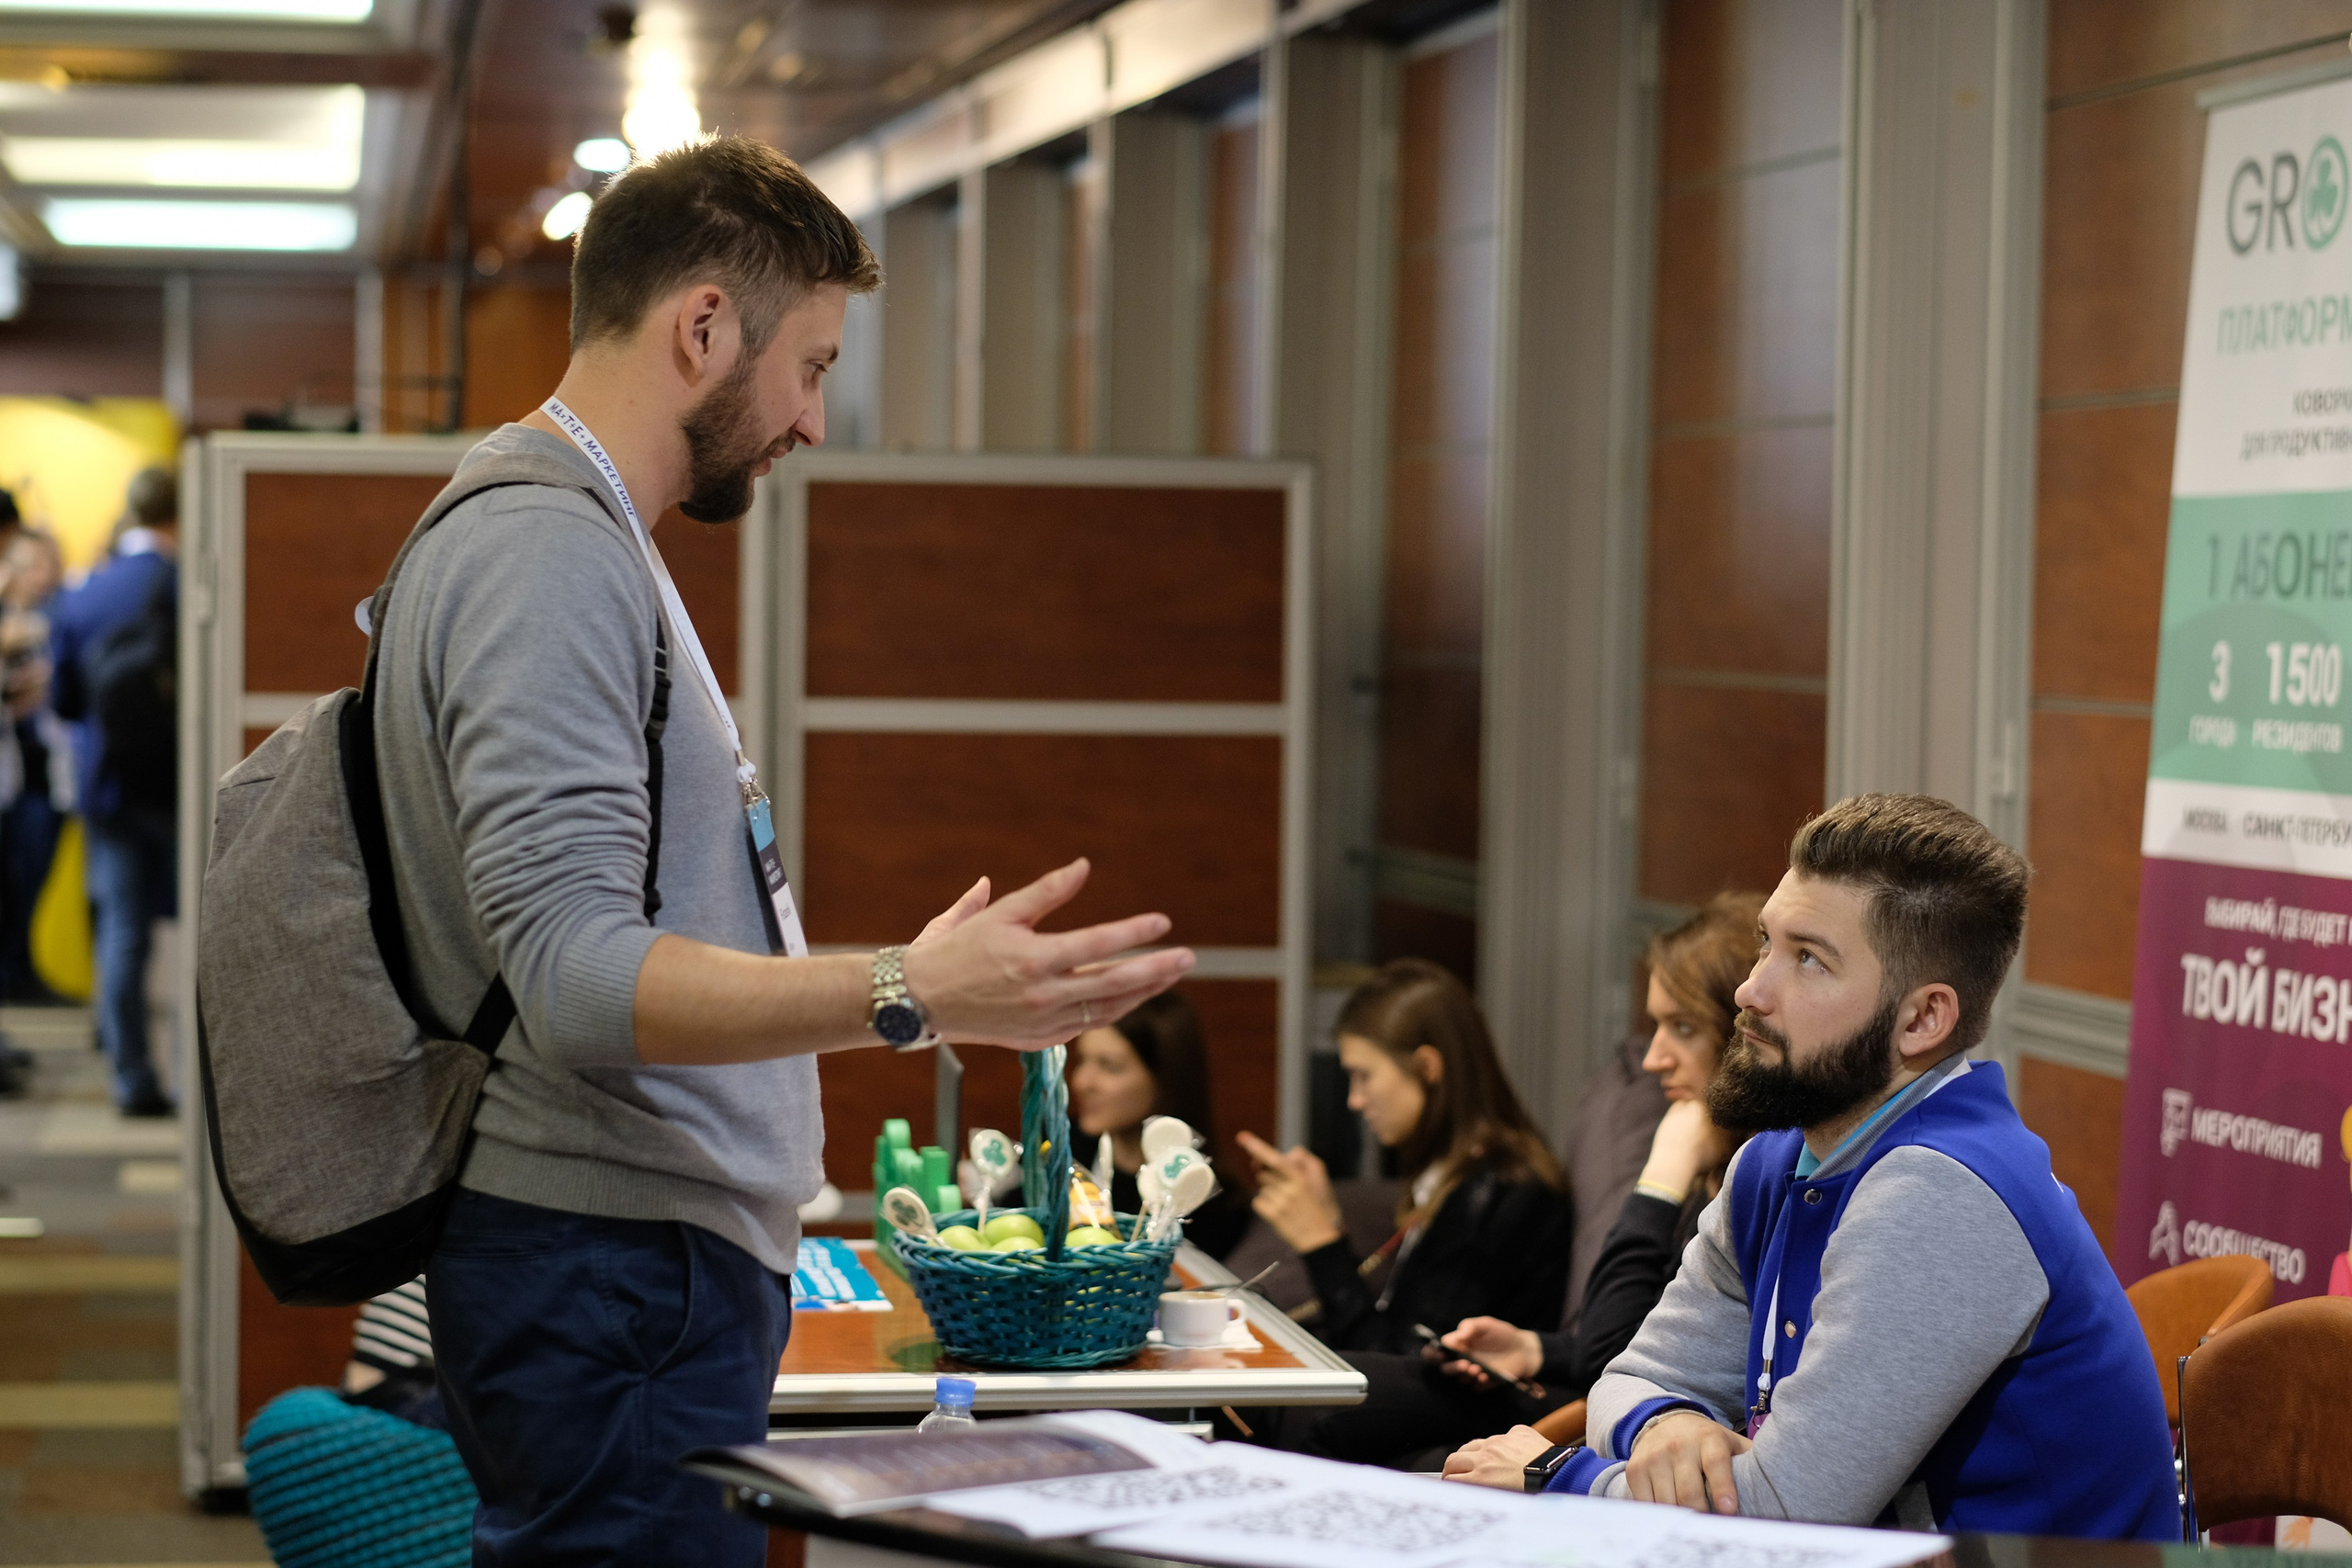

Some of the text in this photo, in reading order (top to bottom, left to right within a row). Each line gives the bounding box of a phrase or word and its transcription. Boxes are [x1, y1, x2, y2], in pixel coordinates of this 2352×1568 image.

[2207, 529, 2352, 601] 1 АБОНЕ
[2209, 639, 2232, 704] 3
[2180, 946, 2269, 1030] ТВОЙ
[2191, 1106, 2323, 1169] МЕРОПРИЯТИЯ
